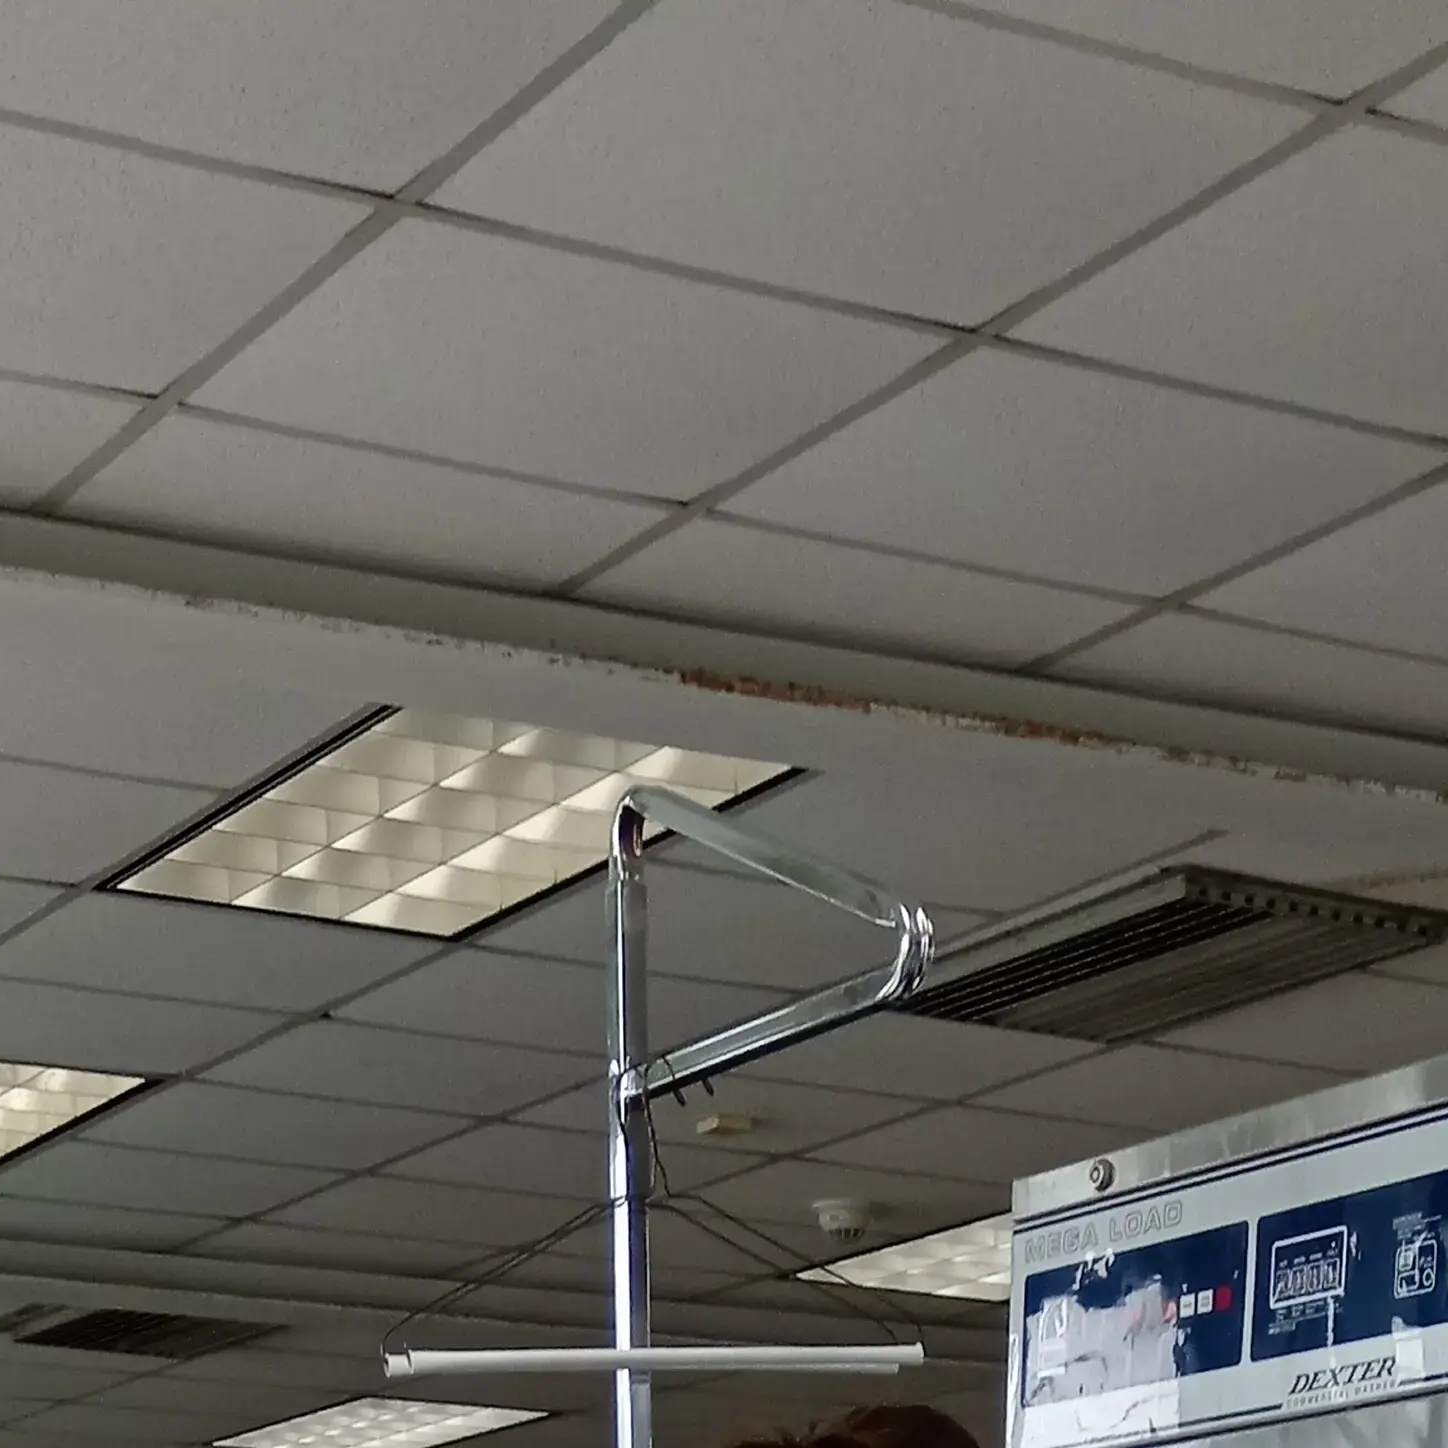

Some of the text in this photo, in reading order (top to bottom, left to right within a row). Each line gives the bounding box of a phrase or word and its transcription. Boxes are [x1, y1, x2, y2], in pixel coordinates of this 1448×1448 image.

[1024, 1199, 1183, 1263] MEGA LOAD
[1288, 1355, 1397, 1397] DEXTER
